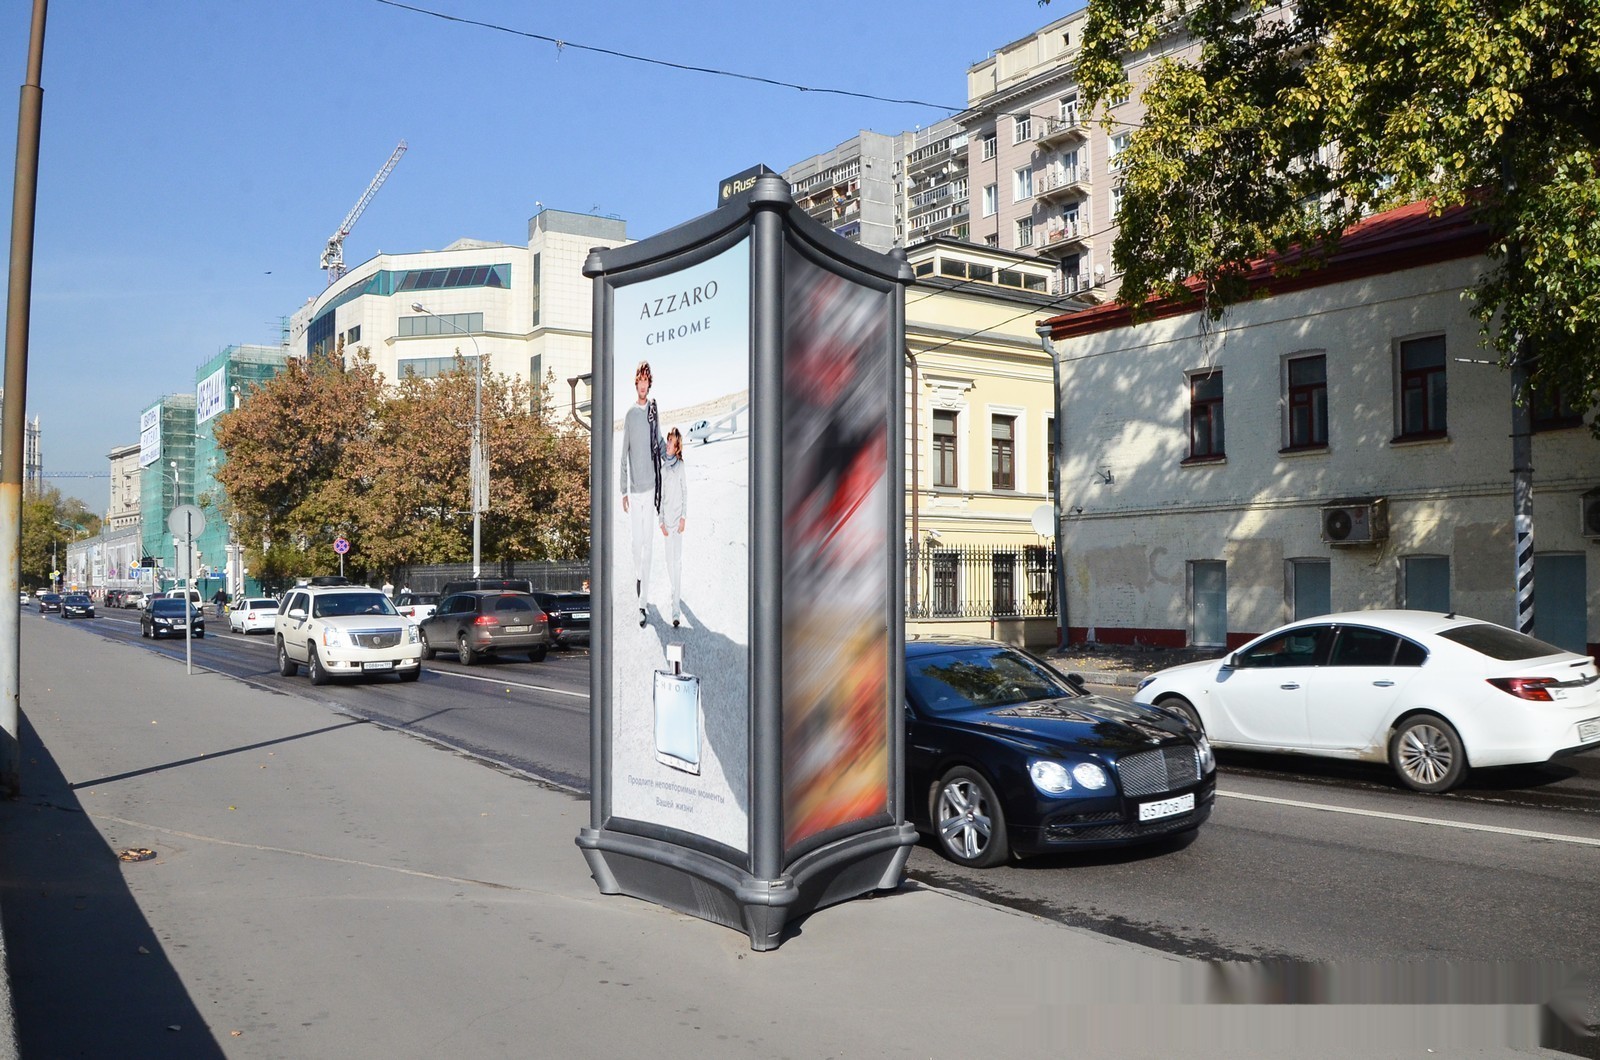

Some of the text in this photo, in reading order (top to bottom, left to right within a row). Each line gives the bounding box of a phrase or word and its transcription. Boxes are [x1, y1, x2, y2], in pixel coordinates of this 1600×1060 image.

[640, 280, 718, 320] AZZARO
[646, 316, 711, 346] CHROME
[655, 679, 697, 696] CHROME
[627, 774, 725, 804] Продлите неповторимые моменты
[655, 796, 694, 813] Вашей жизни
